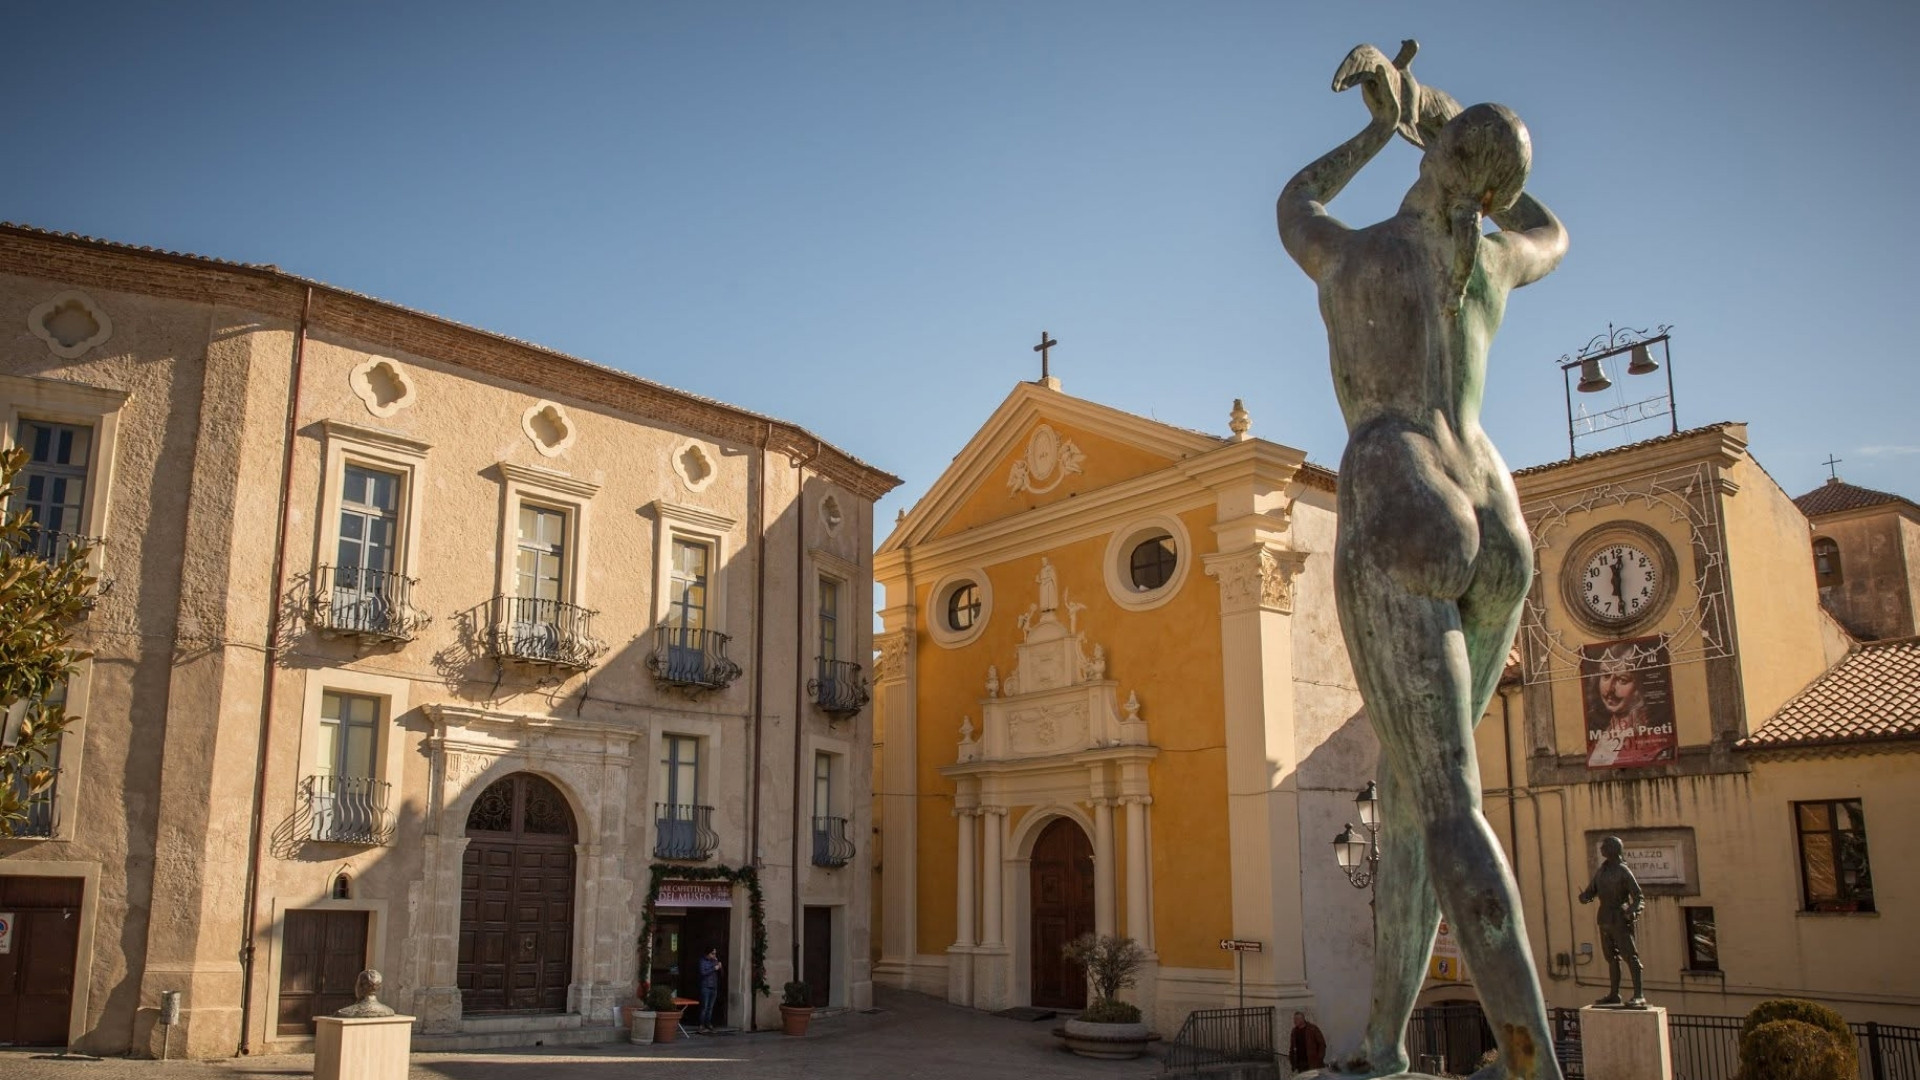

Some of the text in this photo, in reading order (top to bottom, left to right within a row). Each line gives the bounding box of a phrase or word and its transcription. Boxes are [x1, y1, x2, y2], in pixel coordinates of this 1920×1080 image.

[1610, 548, 1622, 559] 12
[1628, 550, 1634, 560] 1
[1598, 555, 1608, 566] 11
[1638, 557, 1646, 567] 2
[1589, 567, 1600, 578] 10
[1645, 571, 1652, 582] 3
[1586, 581, 1593, 591] 9
[1641, 586, 1649, 597] 4
[1592, 594, 1600, 604] 8
[1631, 598, 1639, 608] 5
[1604, 602, 1612, 612] 7
[1638, 722, 1673, 736] Preti
[672, 885, 711, 893] CAFFETTERIA
[659, 892, 674, 901] DEL
[679, 892, 712, 901] MUSEO
